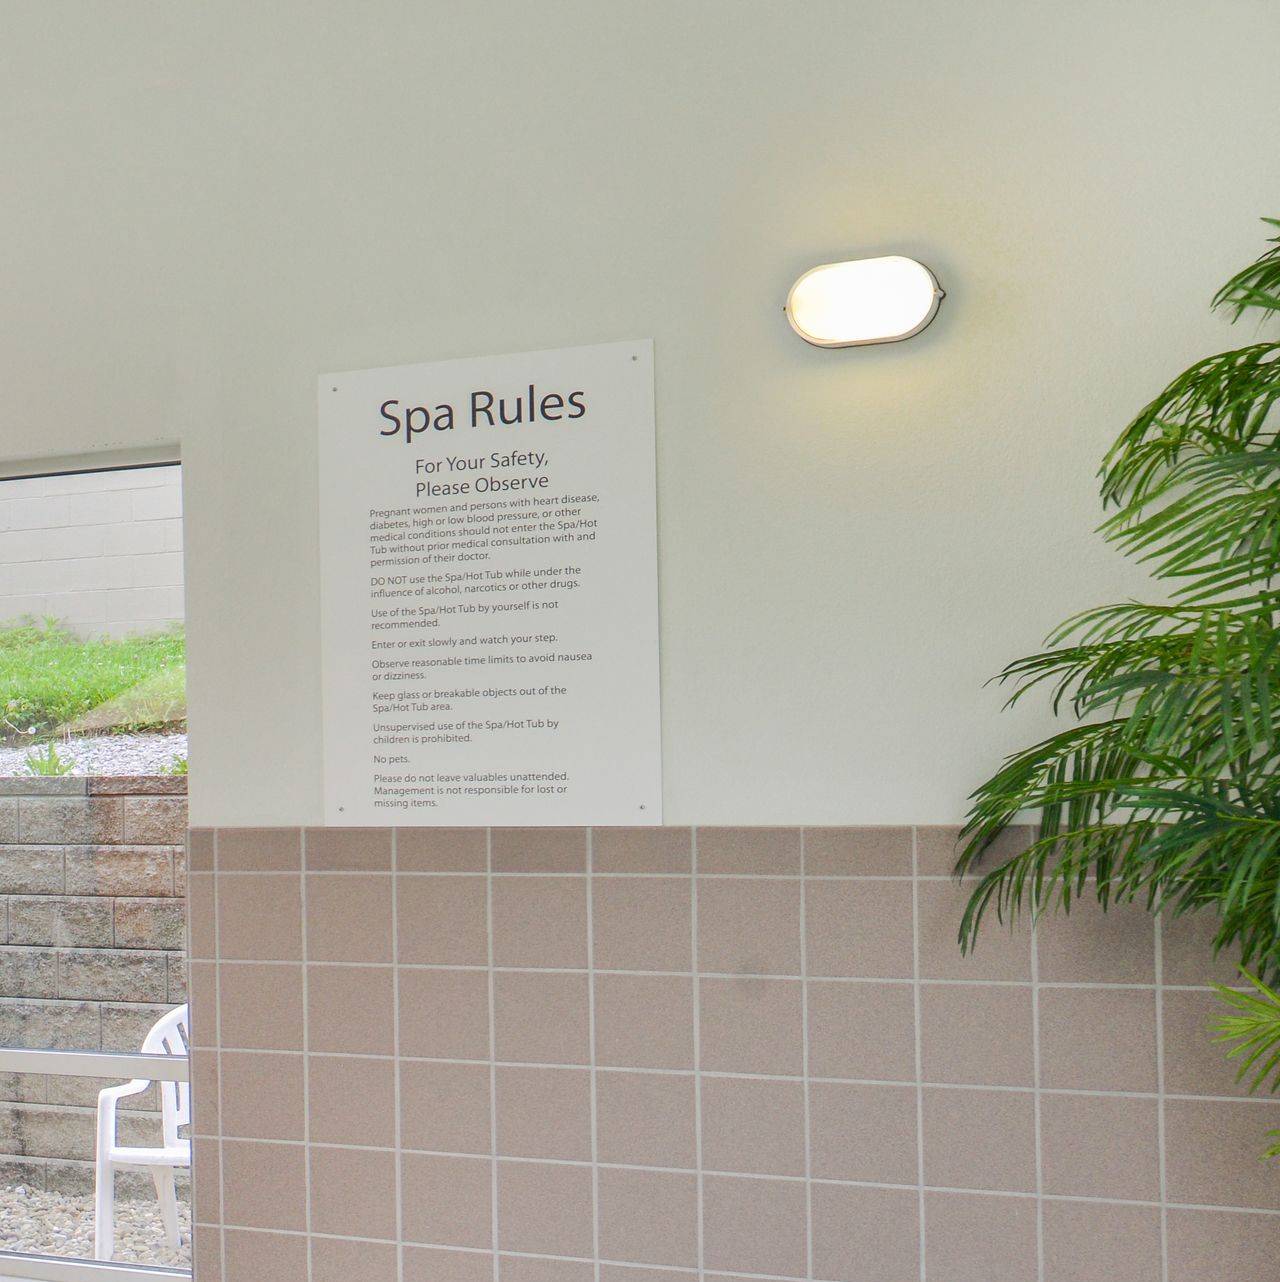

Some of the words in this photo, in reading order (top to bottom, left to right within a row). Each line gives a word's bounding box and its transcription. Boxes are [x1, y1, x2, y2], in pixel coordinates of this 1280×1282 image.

[380, 399, 454, 444] Spa
[471, 385, 586, 428] Rules
[415, 459, 443, 474] For
[445, 456, 486, 472] Your
[490, 450, 549, 469] Safety,
[416, 481, 470, 497] Please
[475, 476, 549, 493] Observe
[369, 508, 411, 519] Pregnant
[413, 506, 448, 515] women
[449, 502, 468, 512] and
[470, 501, 507, 513] persons
[509, 498, 531, 508] with
[533, 497, 559, 506] heart
[560, 494, 600, 504] disease,
[369, 521, 410, 530] diabetes,
[412, 517, 434, 529] high
[435, 518, 446, 526] or
[447, 516, 465, 525] low
[466, 512, 495, 523] blood
[497, 511, 540, 523] pressure,
[542, 510, 553, 518] or
[554, 507, 581, 518] other
[370, 531, 406, 542] medical
[407, 529, 457, 540] conditions
[458, 526, 491, 537] should
[492, 525, 509, 534] not
[511, 524, 537, 533] enter
[539, 522, 555, 531] the
[557, 519, 598, 532] Spa/Hot
[369, 545, 387, 555] Tub
[389, 543, 425, 553] without
[427, 543, 450, 553] prior
[451, 538, 489, 549] medical
[490, 535, 551, 547] consultation
[552, 533, 575, 543] with
[576, 531, 596, 542] and
[370, 557, 420, 569] permission
[422, 554, 432, 564] of
[433, 554, 455, 563] their
[457, 552, 490, 562] doctor.
[370, 576, 386, 587] DO
[387, 575, 407, 585] NOT
[409, 576, 426, 584] use
[427, 574, 443, 583] the
[444, 572, 483, 584] Spa/Hot
[484, 570, 503, 580] Tub
[505, 568, 532, 578] while
[533, 566, 563, 577] under
[564, 565, 582, 575] the
[371, 588, 413, 598] influence
[414, 586, 425, 596] of
[426, 585, 462, 595] alcohol,
[464, 584, 507, 593] narcotics
[508, 583, 520, 591] or
[521, 580, 548, 591] other
[549, 579, 581, 590] drugs.
[371, 609, 388, 618] Use
[389, 607, 400, 617] of
[401, 607, 417, 617] the
[418, 605, 457, 617] Spa/Hot
[457, 604, 476, 614] Tub
[477, 603, 490, 614] by
[491, 600, 531, 614] yourself
[532, 601, 540, 610] is
[541, 601, 559, 609] not
[371, 618, 441, 630] recommended.
[371, 640, 396, 650] Enter
[397, 641, 407, 649] or
[409, 639, 426, 648] exit
[428, 636, 458, 648] slowly
[459, 635, 478, 646] and
[479, 634, 509, 645] watch
[510, 635, 533, 646] your
[534, 634, 558, 644] step.
[371, 659, 410, 669] Observe
[411, 656, 463, 667] reasonable
[464, 656, 486, 665] time
[487, 655, 514, 664] limits
[516, 655, 527, 664] to
[528, 652, 555, 663] avoid
[557, 653, 593, 662] nausea
[383, 672, 426, 681] dizziness.
[372, 692, 396, 702] Keep
[397, 690, 420, 702] glass
[434, 688, 481, 699] breakable
[482, 687, 518, 699] objects
[519, 687, 536, 696] out
[537, 685, 550, 695] of
[550, 685, 567, 695] the
[372, 703, 410, 714] Spa/Hot
[411, 702, 429, 712] Tub
[430, 703, 453, 711] area.
[373, 721, 435, 733] Unsupervised
[437, 723, 454, 731] use
[455, 720, 466, 730] of
[467, 721, 484, 730] the
[485, 719, 524, 731] Spa/Hot
[525, 719, 545, 728] Tub
[546, 719, 560, 730] by
[374, 774, 403, 783] Please
[404, 774, 417, 783] do
[418, 775, 435, 783] not
[436, 773, 461, 783] leave
[463, 772, 508, 782] valuables
[510, 771, 569, 782] unattended.
